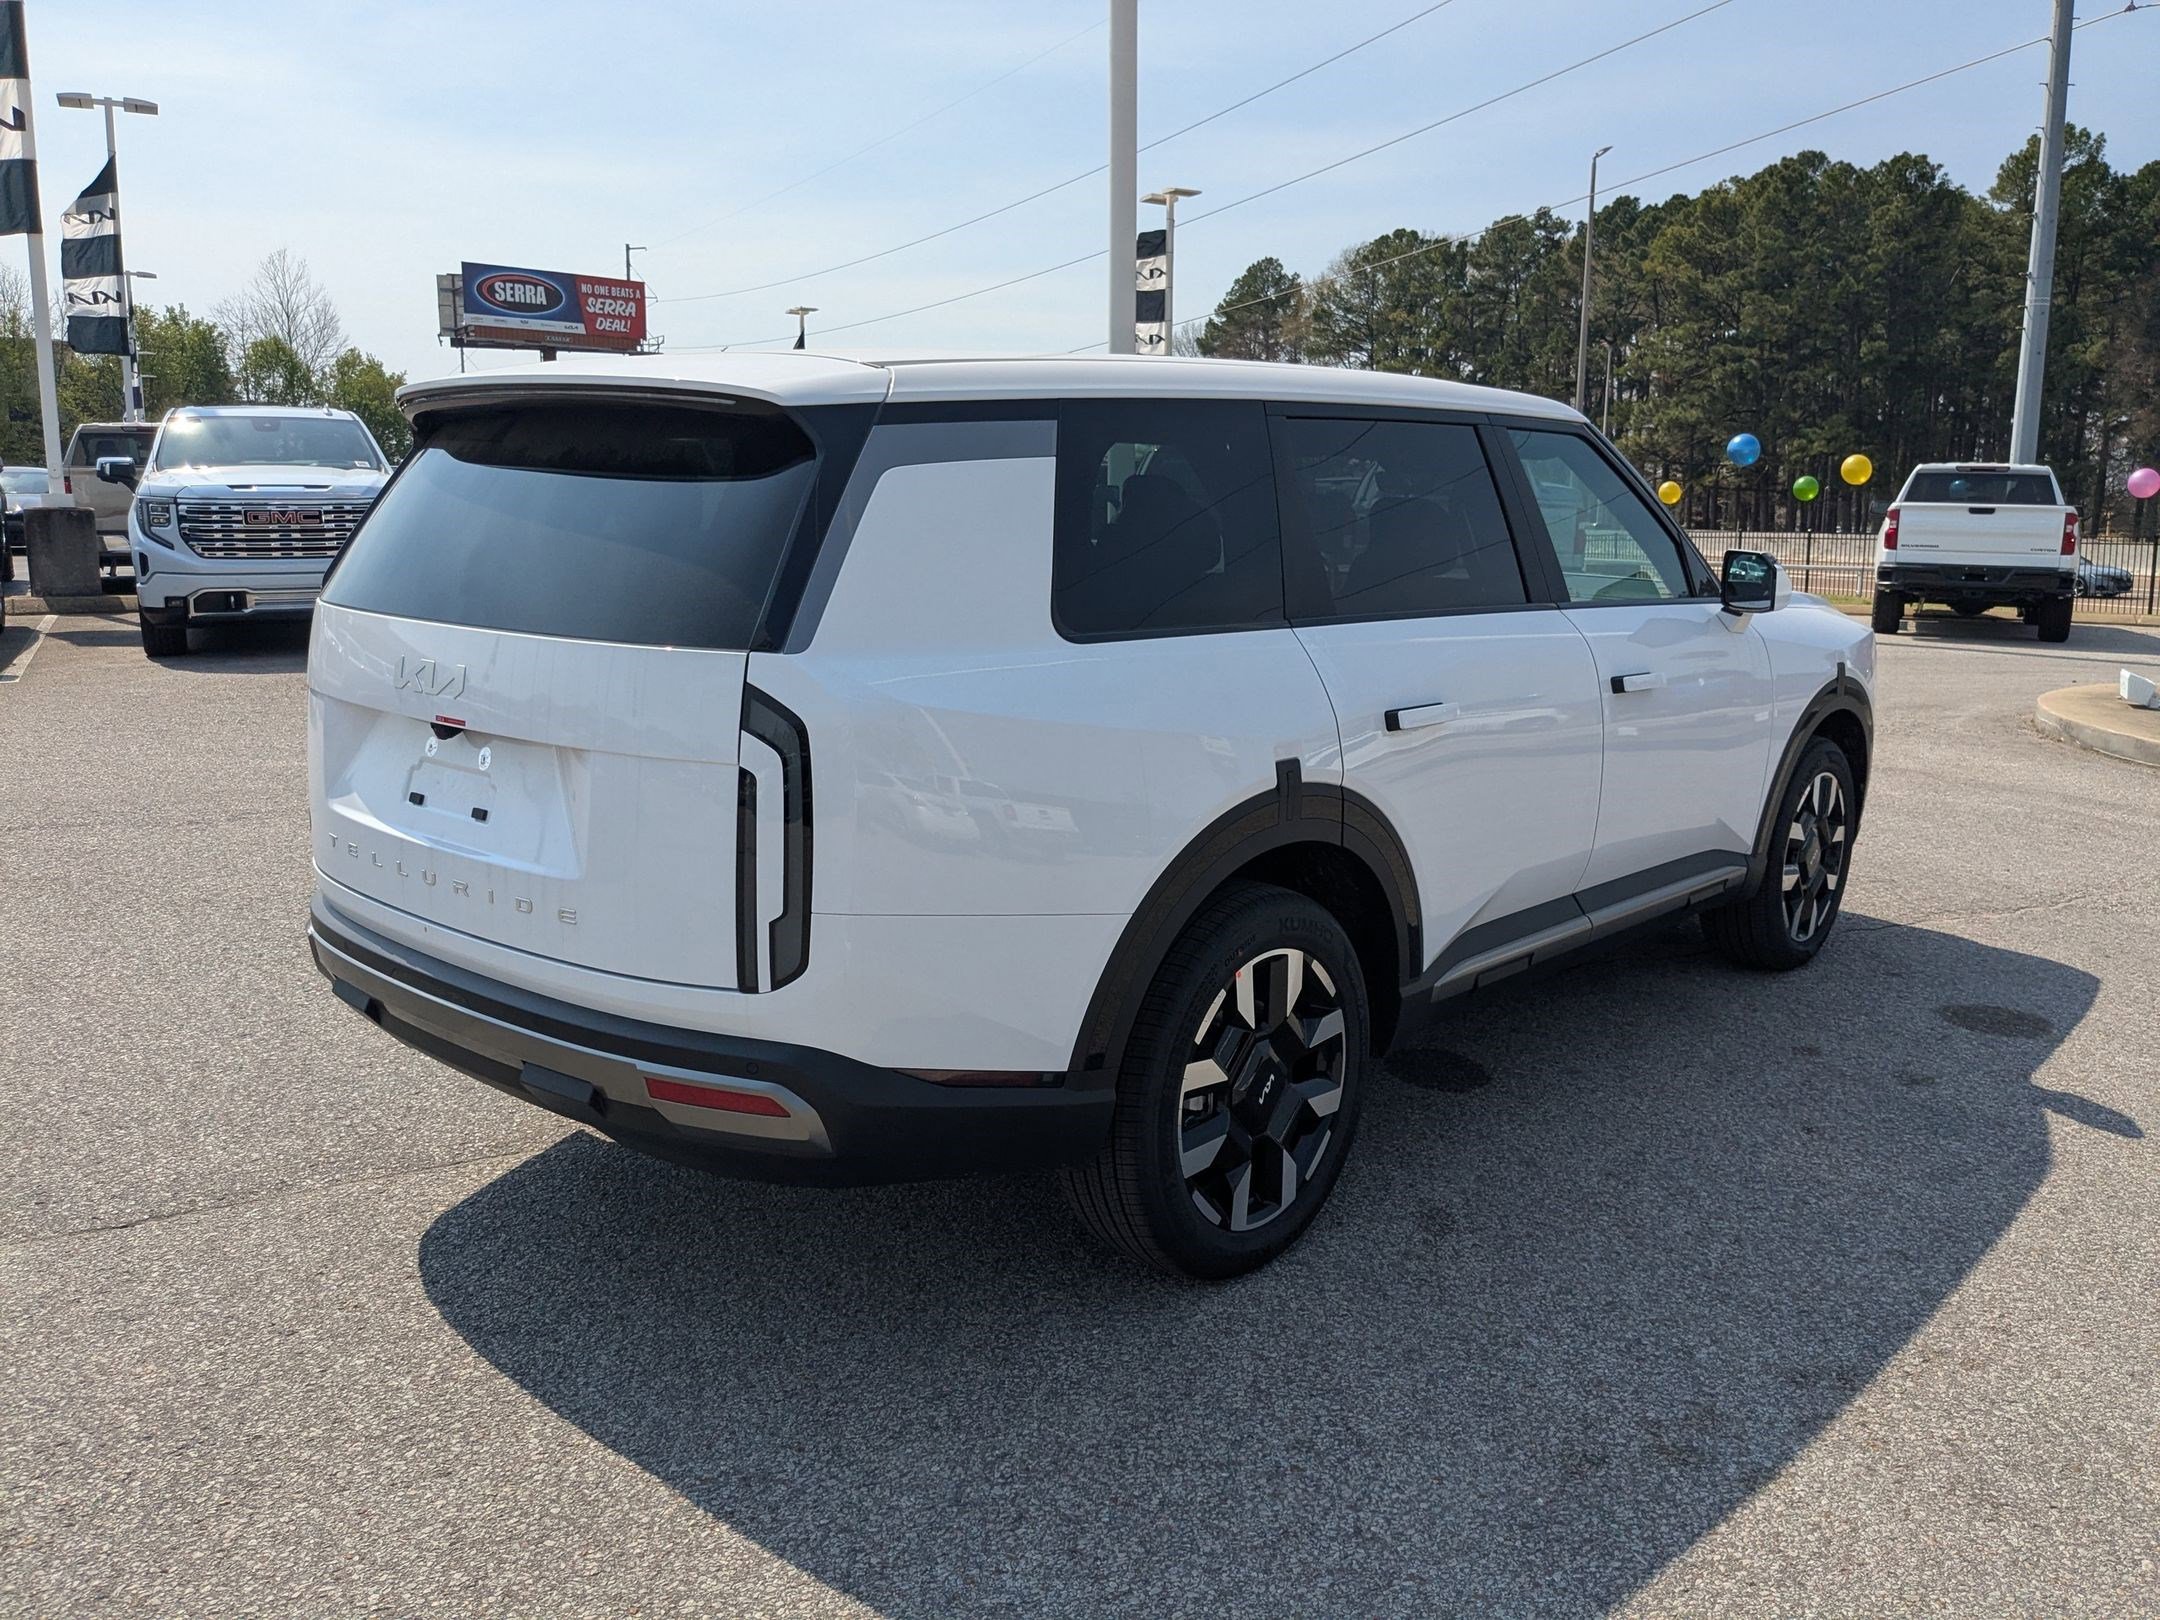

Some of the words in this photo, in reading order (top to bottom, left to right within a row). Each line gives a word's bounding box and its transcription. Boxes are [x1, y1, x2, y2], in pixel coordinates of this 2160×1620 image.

[493, 280, 548, 306] SERRA
[581, 282, 593, 294] NO
[594, 284, 610, 297] ONE
[611, 286, 634, 298] BEATS
[634, 288, 641, 299] A
[585, 296, 637, 318] SERRA
[596, 316, 631, 333] DEAL!
[247, 511, 320, 524] GMC
[328, 831, 579, 926] TELLURIDE
